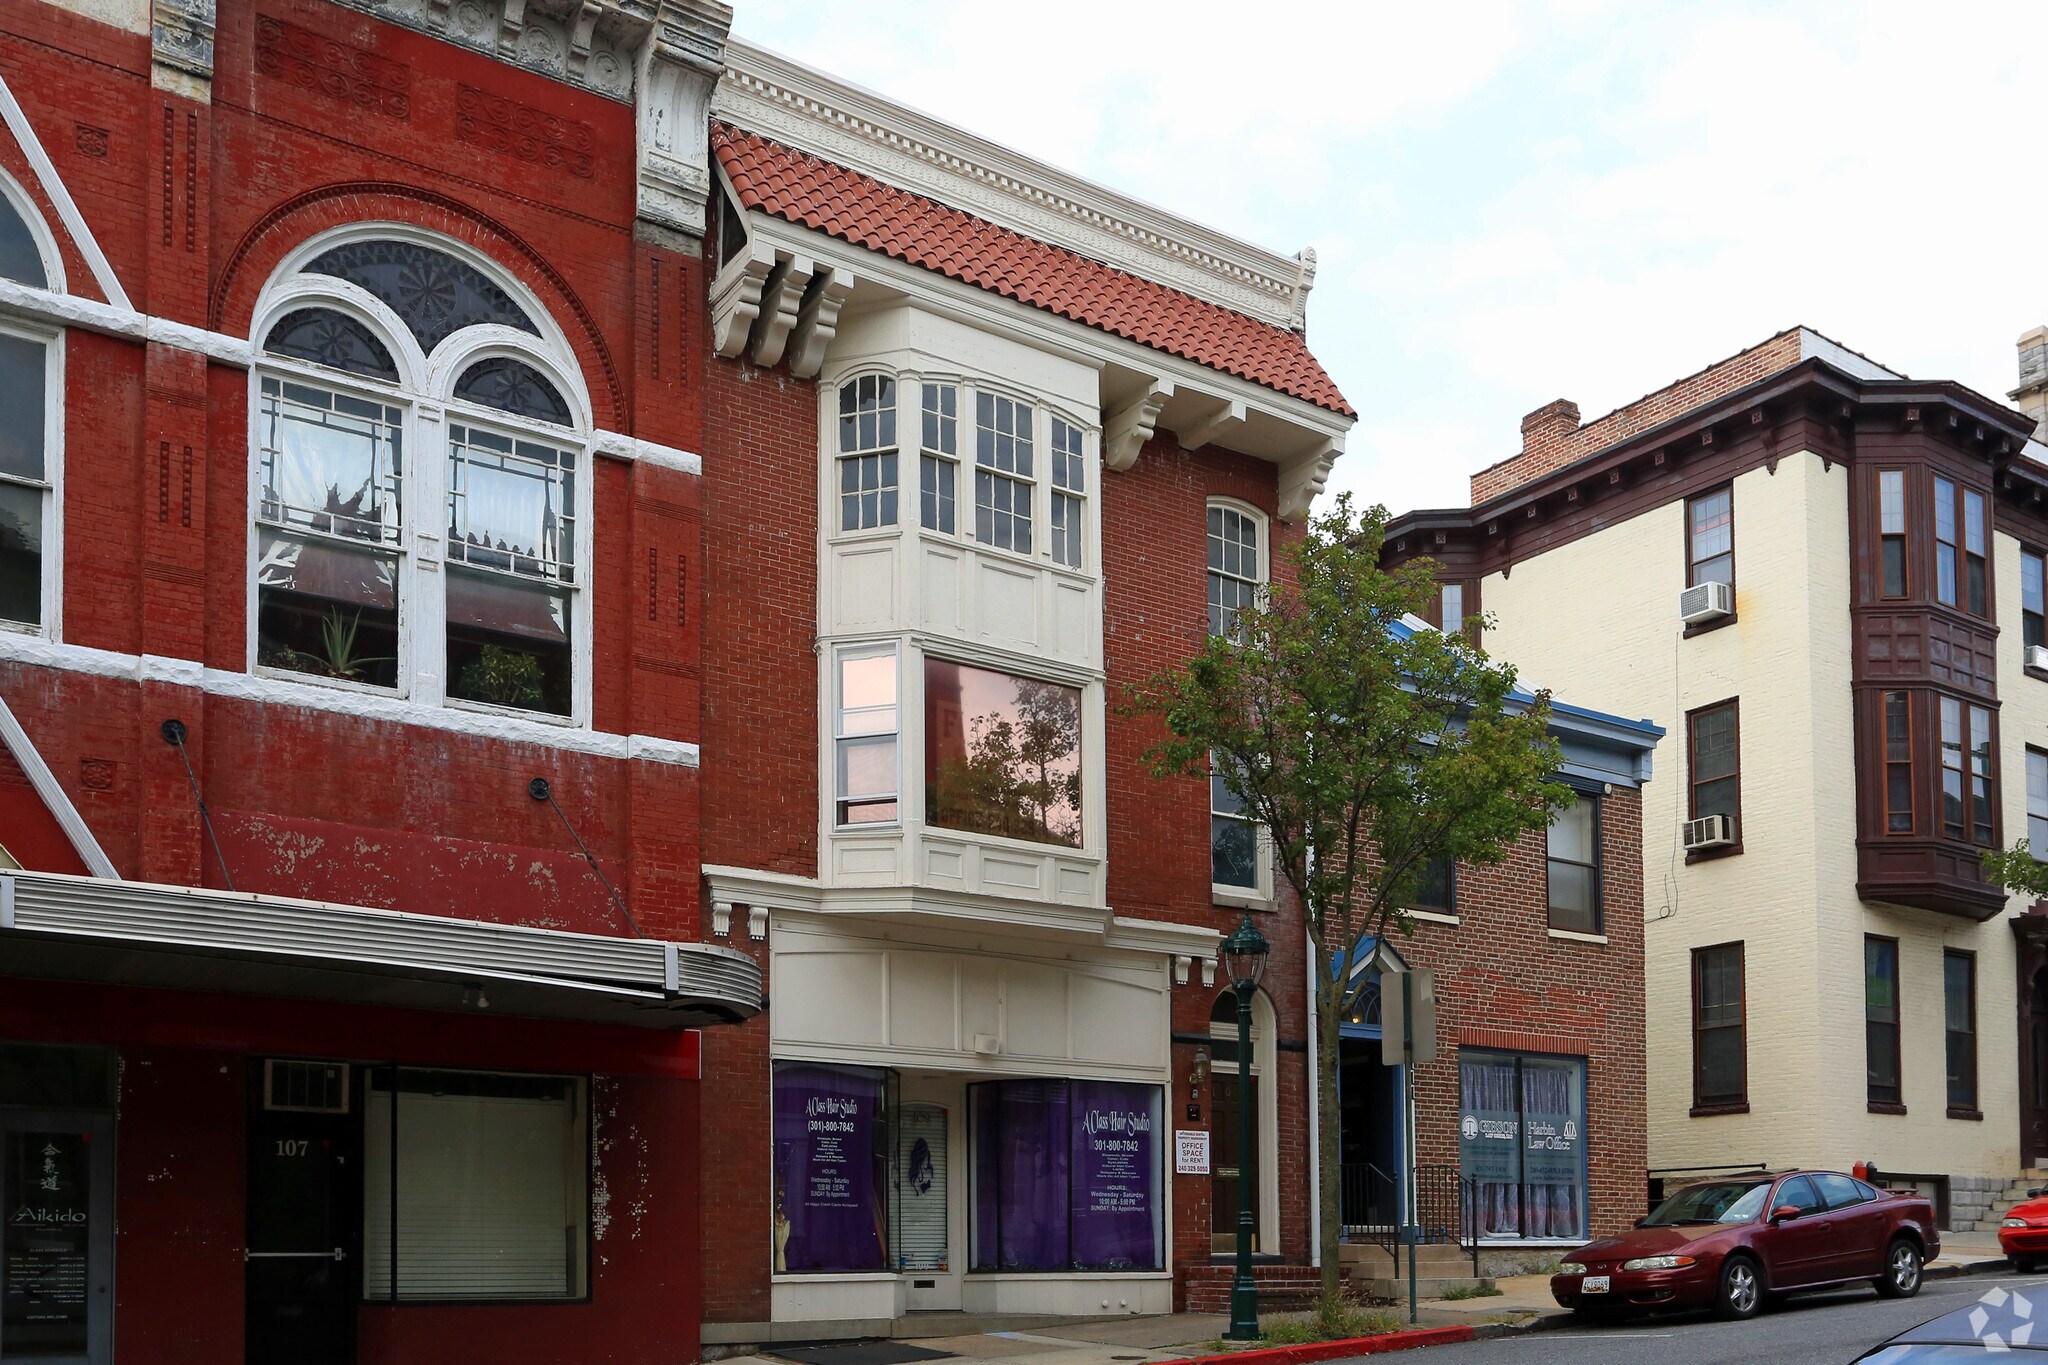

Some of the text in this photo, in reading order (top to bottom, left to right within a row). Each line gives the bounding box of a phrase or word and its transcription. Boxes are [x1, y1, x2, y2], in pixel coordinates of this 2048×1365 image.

[805, 1097, 857, 1118] A Class Hair Studio
[808, 1120, 854, 1133] (301)-800-7842
[1082, 1110, 1150, 1137] A Class Hair Studio
[1479, 1119, 1518, 1135] GIBSON
[1528, 1121, 1556, 1136] Harbin
[276, 1139, 309, 1157] 107
[1094, 1139, 1138, 1151] 301-800-7842
[1182, 1142, 1203, 1150] OFFICE
[1528, 1135, 1545, 1149] Law
[1545, 1136, 1571, 1151] Office
[1182, 1149, 1203, 1157] SPACE
[15, 1207, 86, 1222] Aikido
